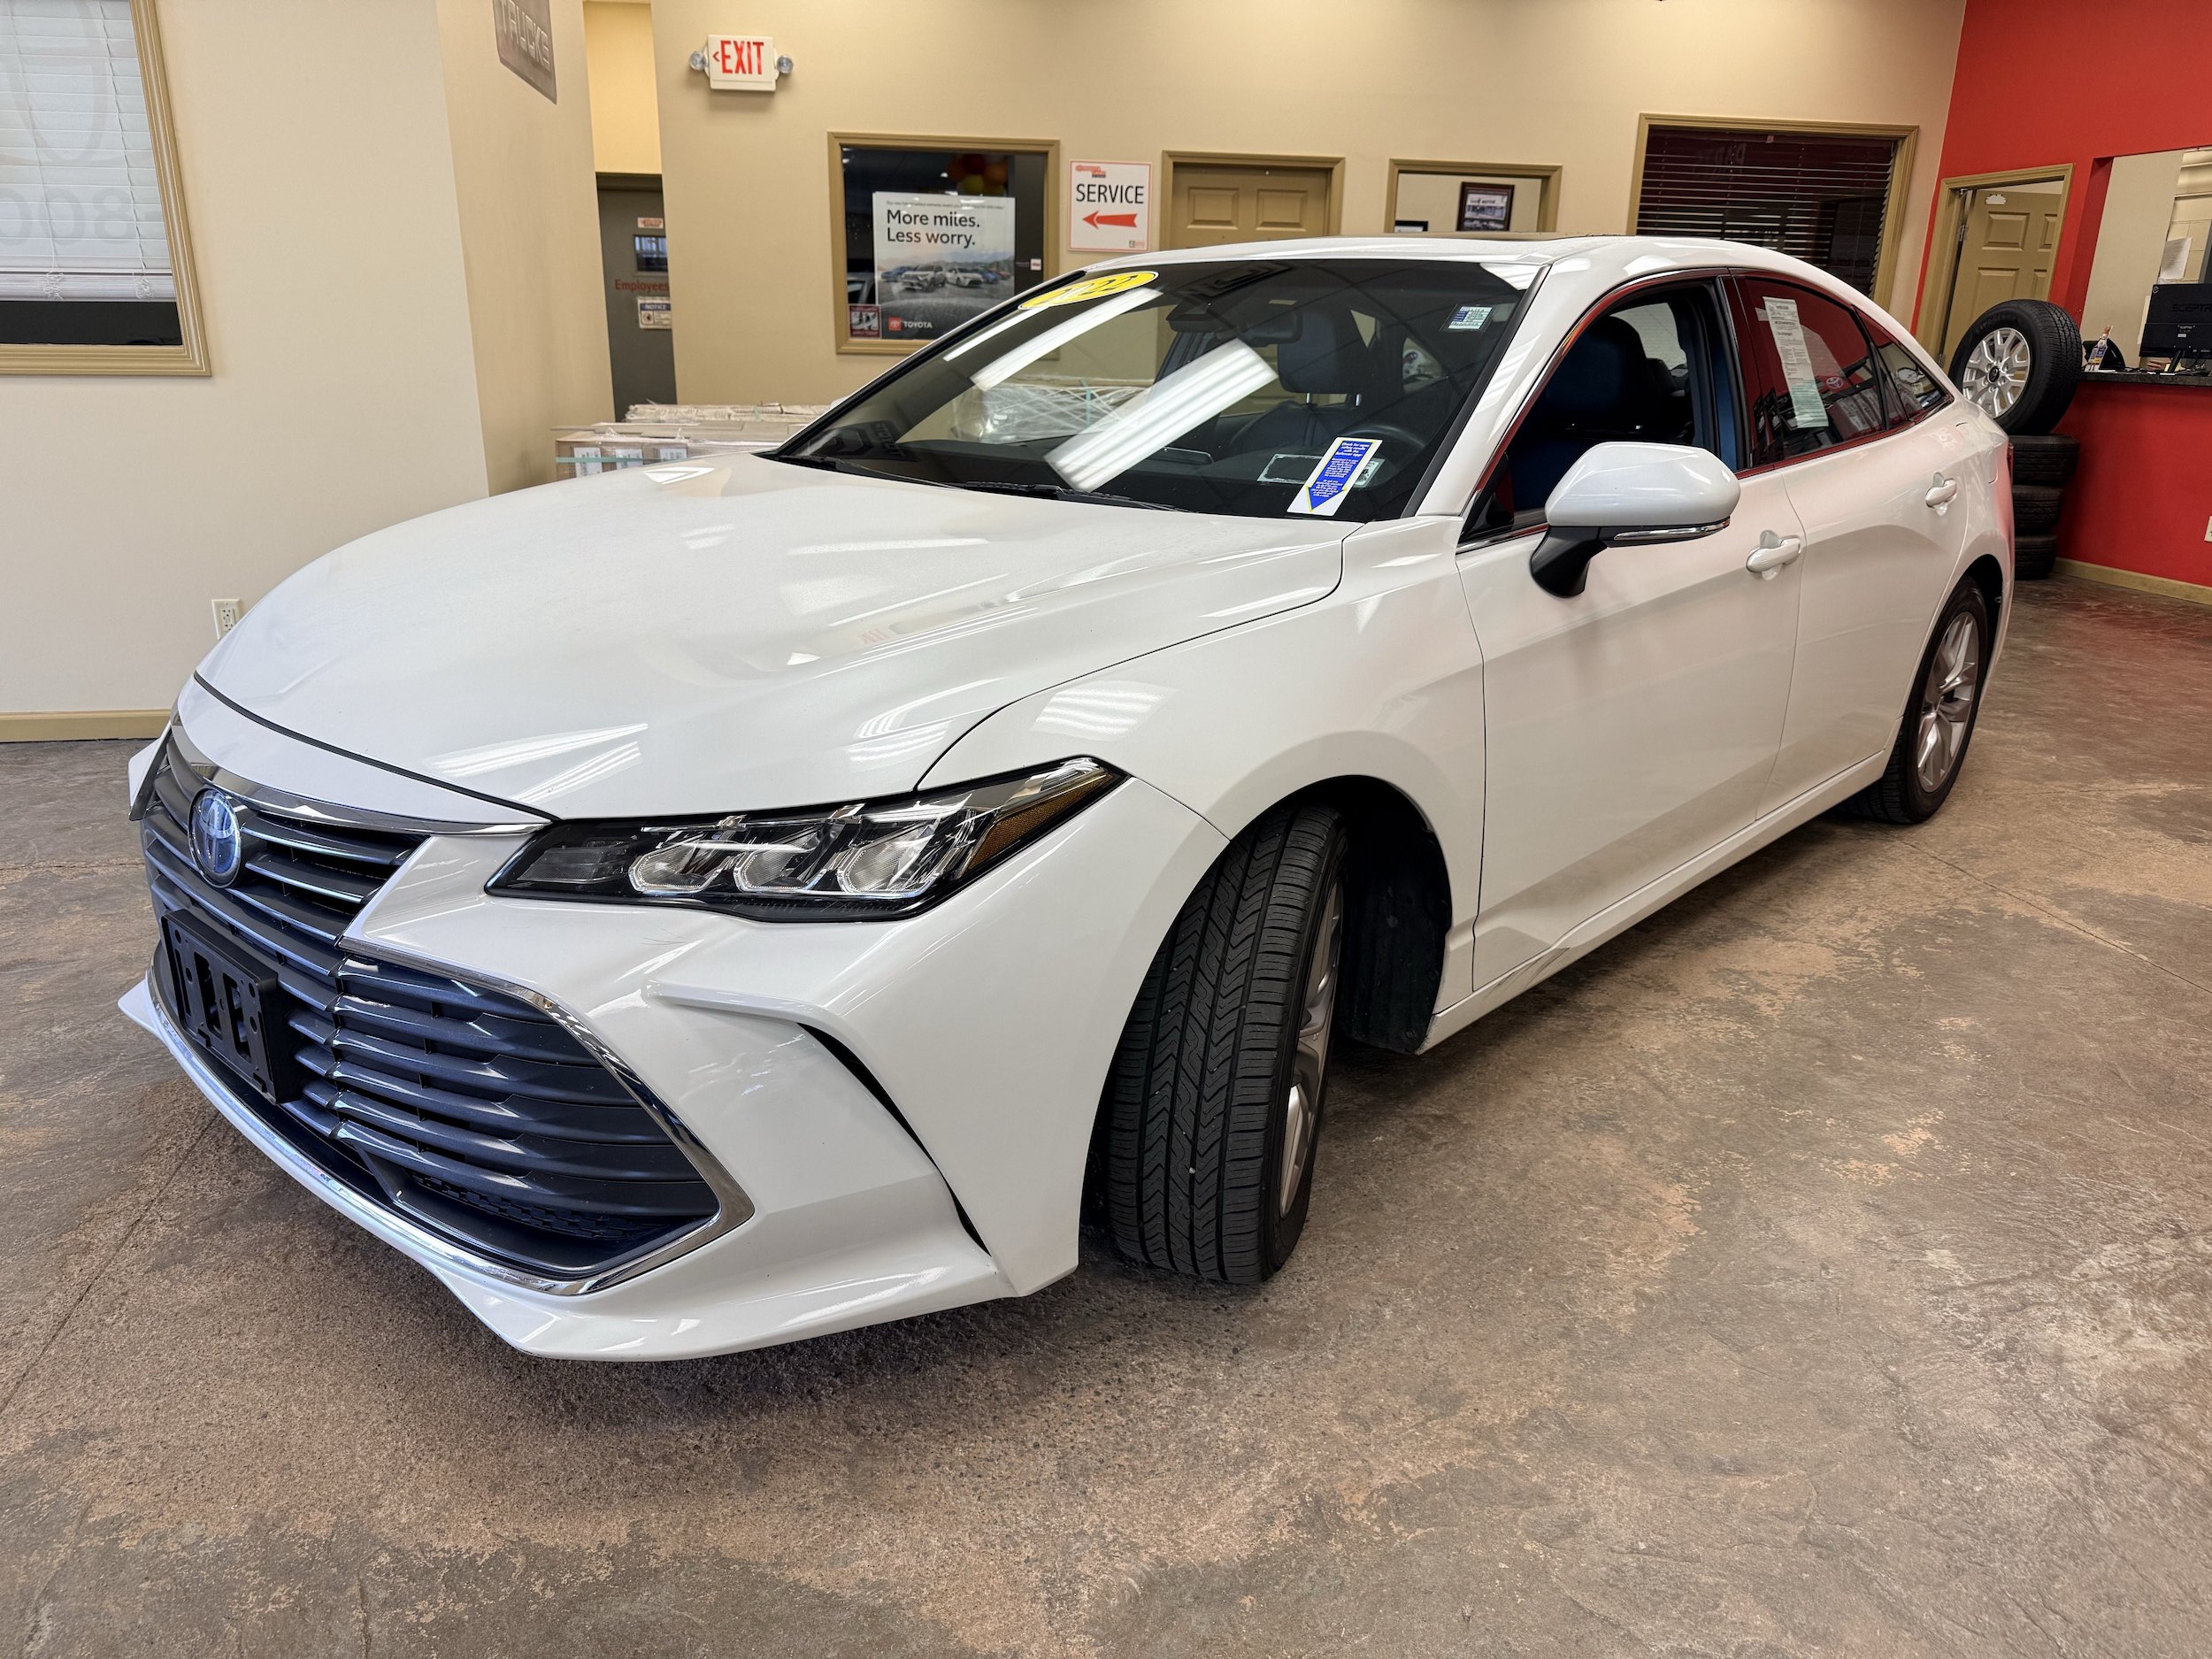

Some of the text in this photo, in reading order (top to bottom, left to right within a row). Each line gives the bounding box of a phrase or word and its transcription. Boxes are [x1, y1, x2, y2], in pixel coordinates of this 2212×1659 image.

[720, 40, 764, 75] EXIT
[1076, 183, 1144, 204] SERVICE
[887, 209, 980, 227] More miles.
[887, 227, 976, 249] Less worry.
